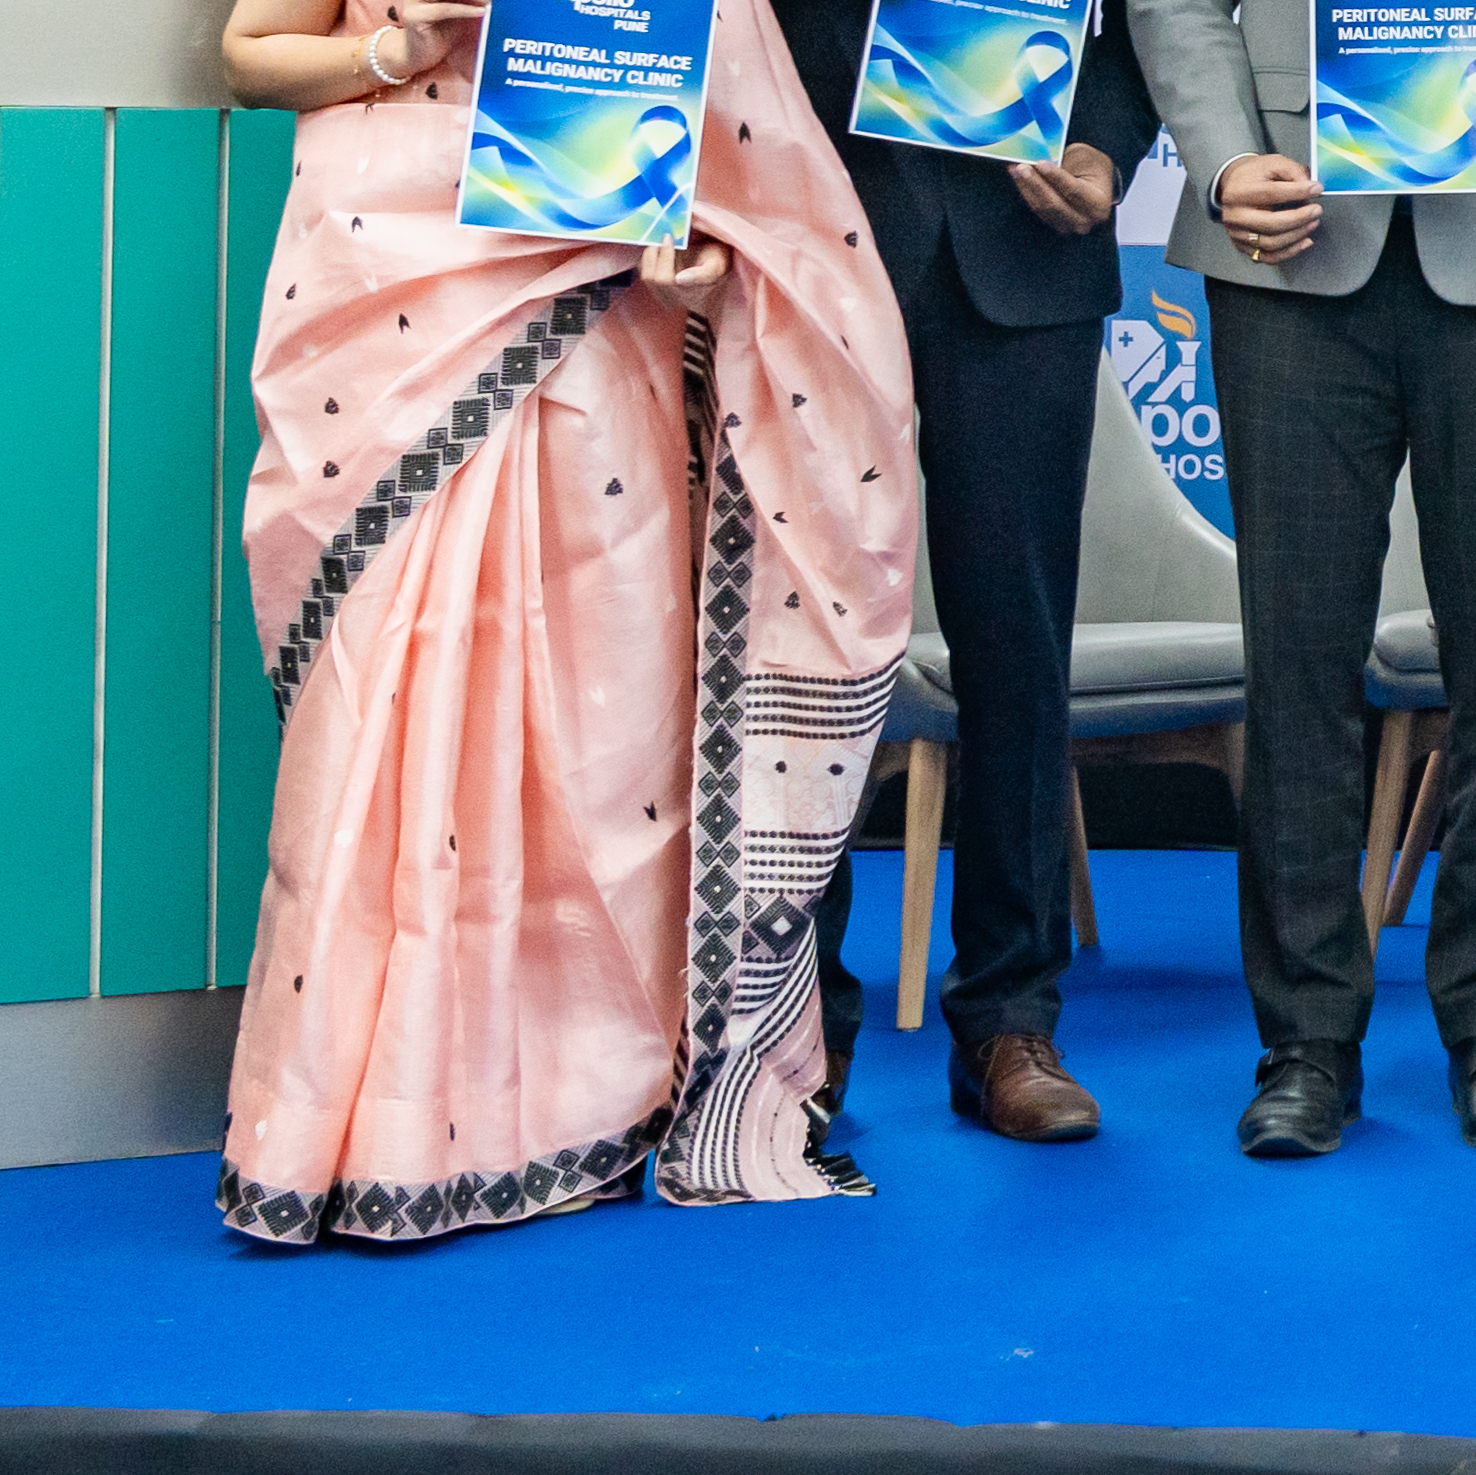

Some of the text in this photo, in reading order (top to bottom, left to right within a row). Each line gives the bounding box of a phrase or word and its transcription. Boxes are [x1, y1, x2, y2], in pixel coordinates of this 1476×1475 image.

[580, 4, 651, 20] HOSPITALS
[1331, 8, 1431, 23] PERITONEAL
[613, 19, 649, 32] PUNE
[1337, 25, 1444, 41] MALIGNANCY
[503, 37, 693, 71] PERITONEAL SURFACE
[506, 57, 684, 88] MALIGNANCY CLINIC
